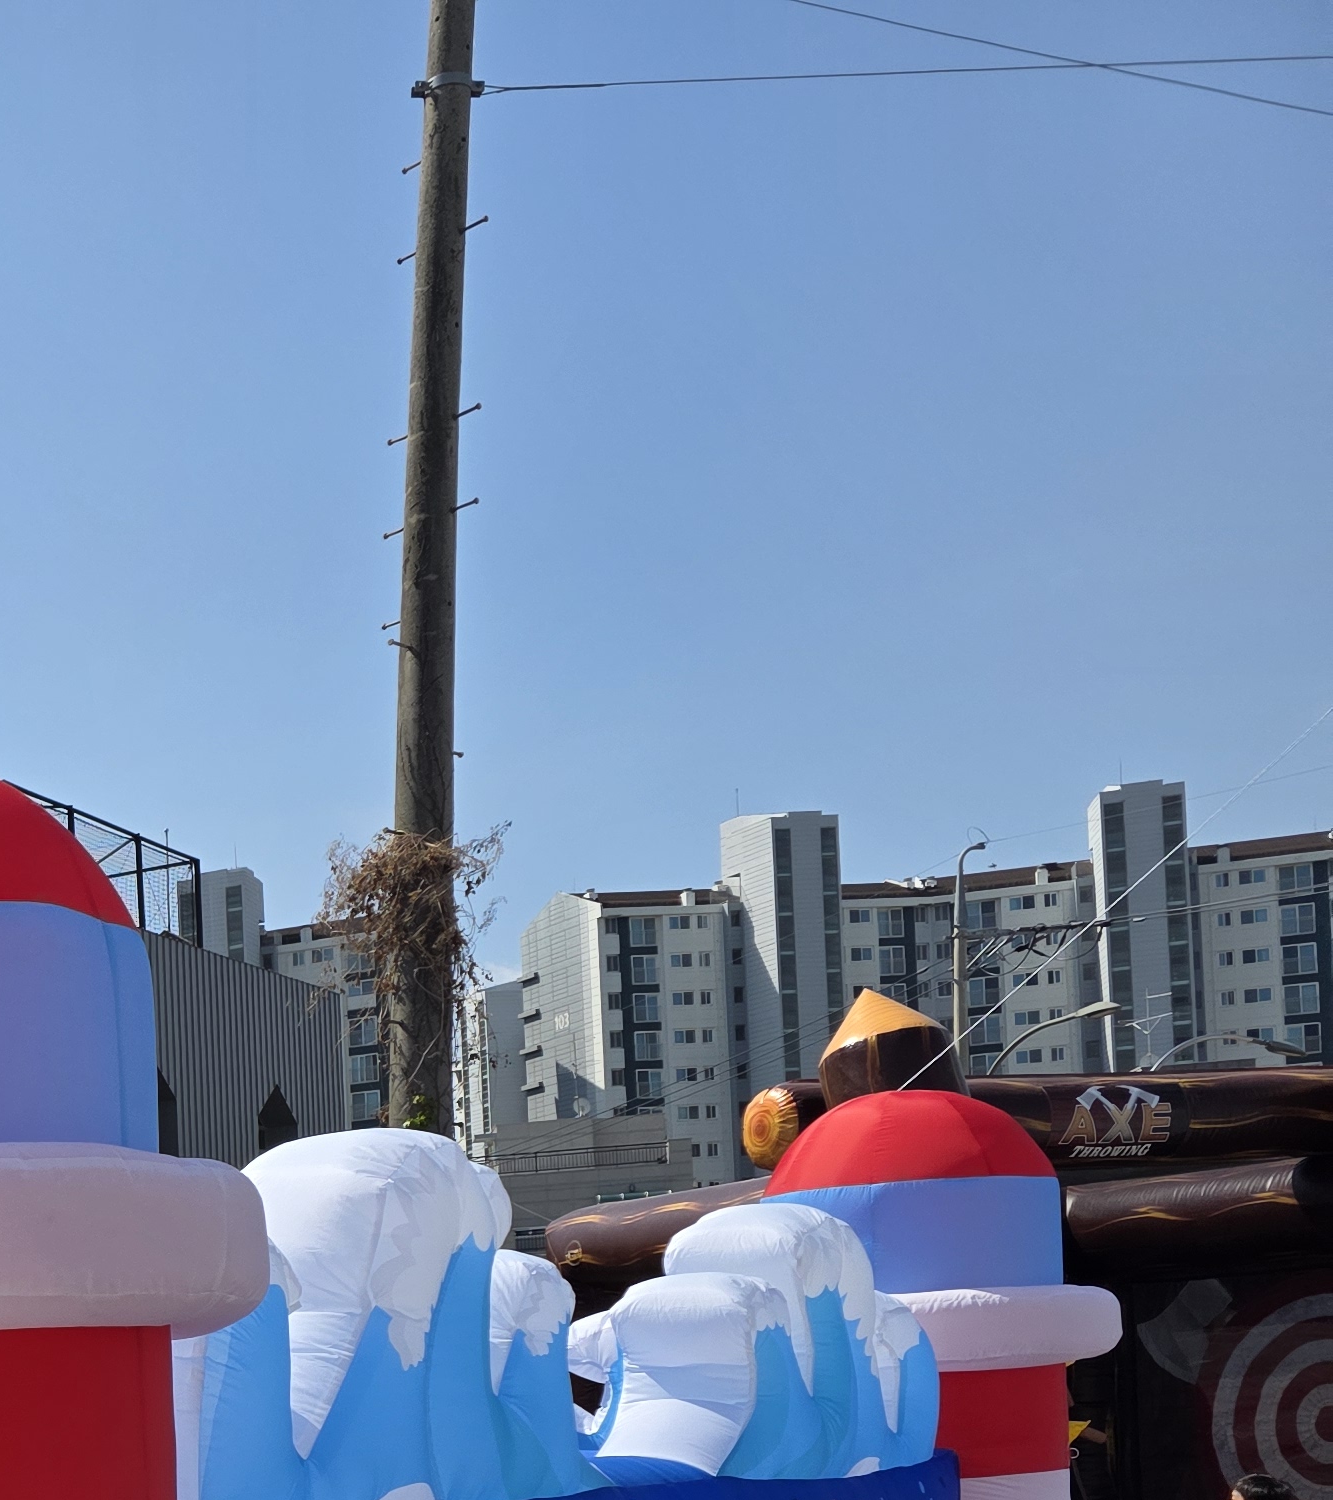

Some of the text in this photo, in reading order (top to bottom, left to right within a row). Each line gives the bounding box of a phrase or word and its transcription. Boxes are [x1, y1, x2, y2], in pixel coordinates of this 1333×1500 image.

[555, 1012, 570, 1031] 103
[1058, 1103, 1172, 1144] AXE
[1069, 1144, 1151, 1158] THROWING
